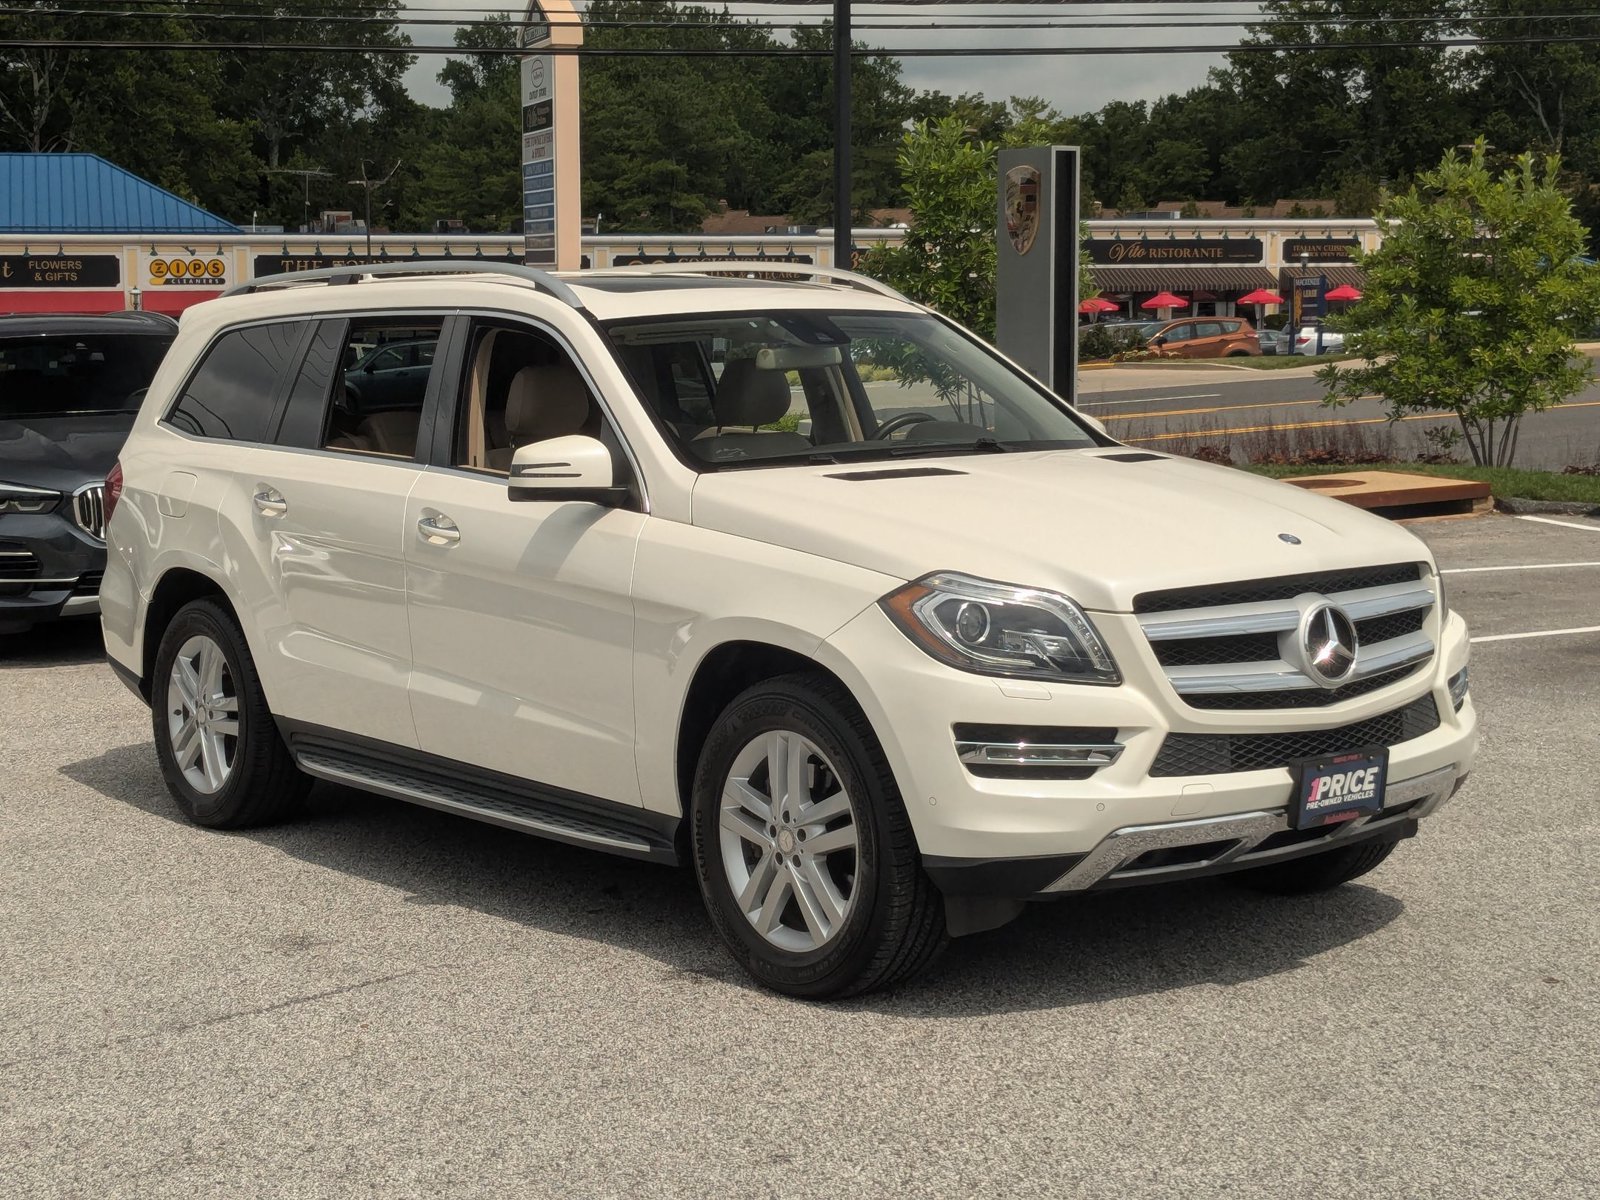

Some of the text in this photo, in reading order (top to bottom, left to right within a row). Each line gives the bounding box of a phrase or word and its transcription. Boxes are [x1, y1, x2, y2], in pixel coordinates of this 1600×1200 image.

[1109, 242, 1224, 262] Vito RISTORANTE
[1293, 244, 1347, 252] ITALIAN CUISIN
[28, 260, 82, 270] FLOWERS
[152, 261, 222, 275] ZIPS
[281, 260, 323, 272] THE
[34, 271, 78, 281] & GIFTS
[1306, 796, 1342, 811] PRE-OWNED
[695, 808, 710, 882] KUMHO
